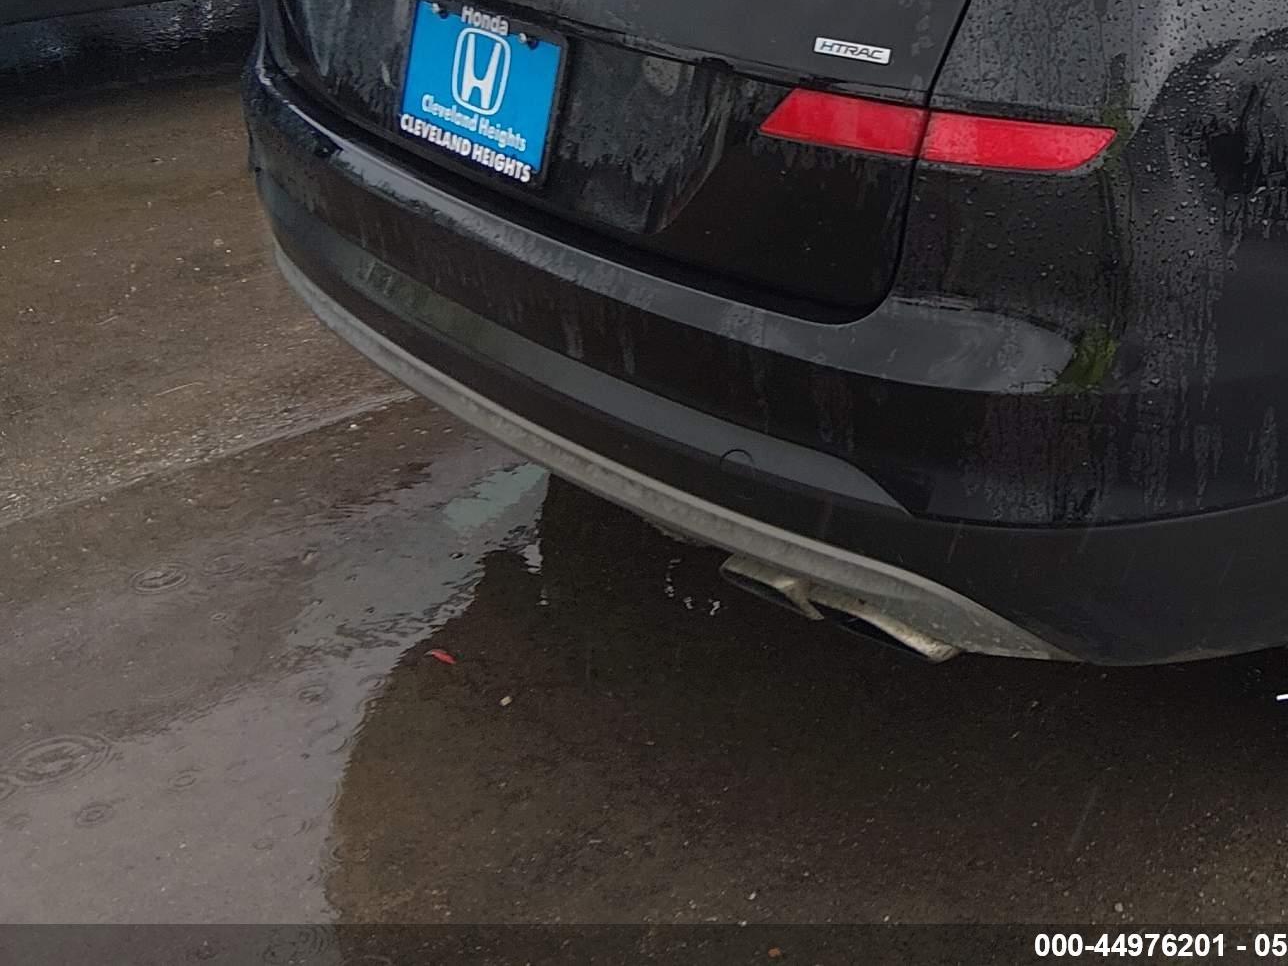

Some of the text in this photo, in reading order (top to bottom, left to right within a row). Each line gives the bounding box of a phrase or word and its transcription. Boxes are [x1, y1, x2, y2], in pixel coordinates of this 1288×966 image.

[461, 5, 510, 36] Honda
[819, 40, 884, 61] HTRAC
[421, 93, 527, 152] Cleveland Heights
[400, 113, 533, 183] CLEVELAND HEIGHTS
